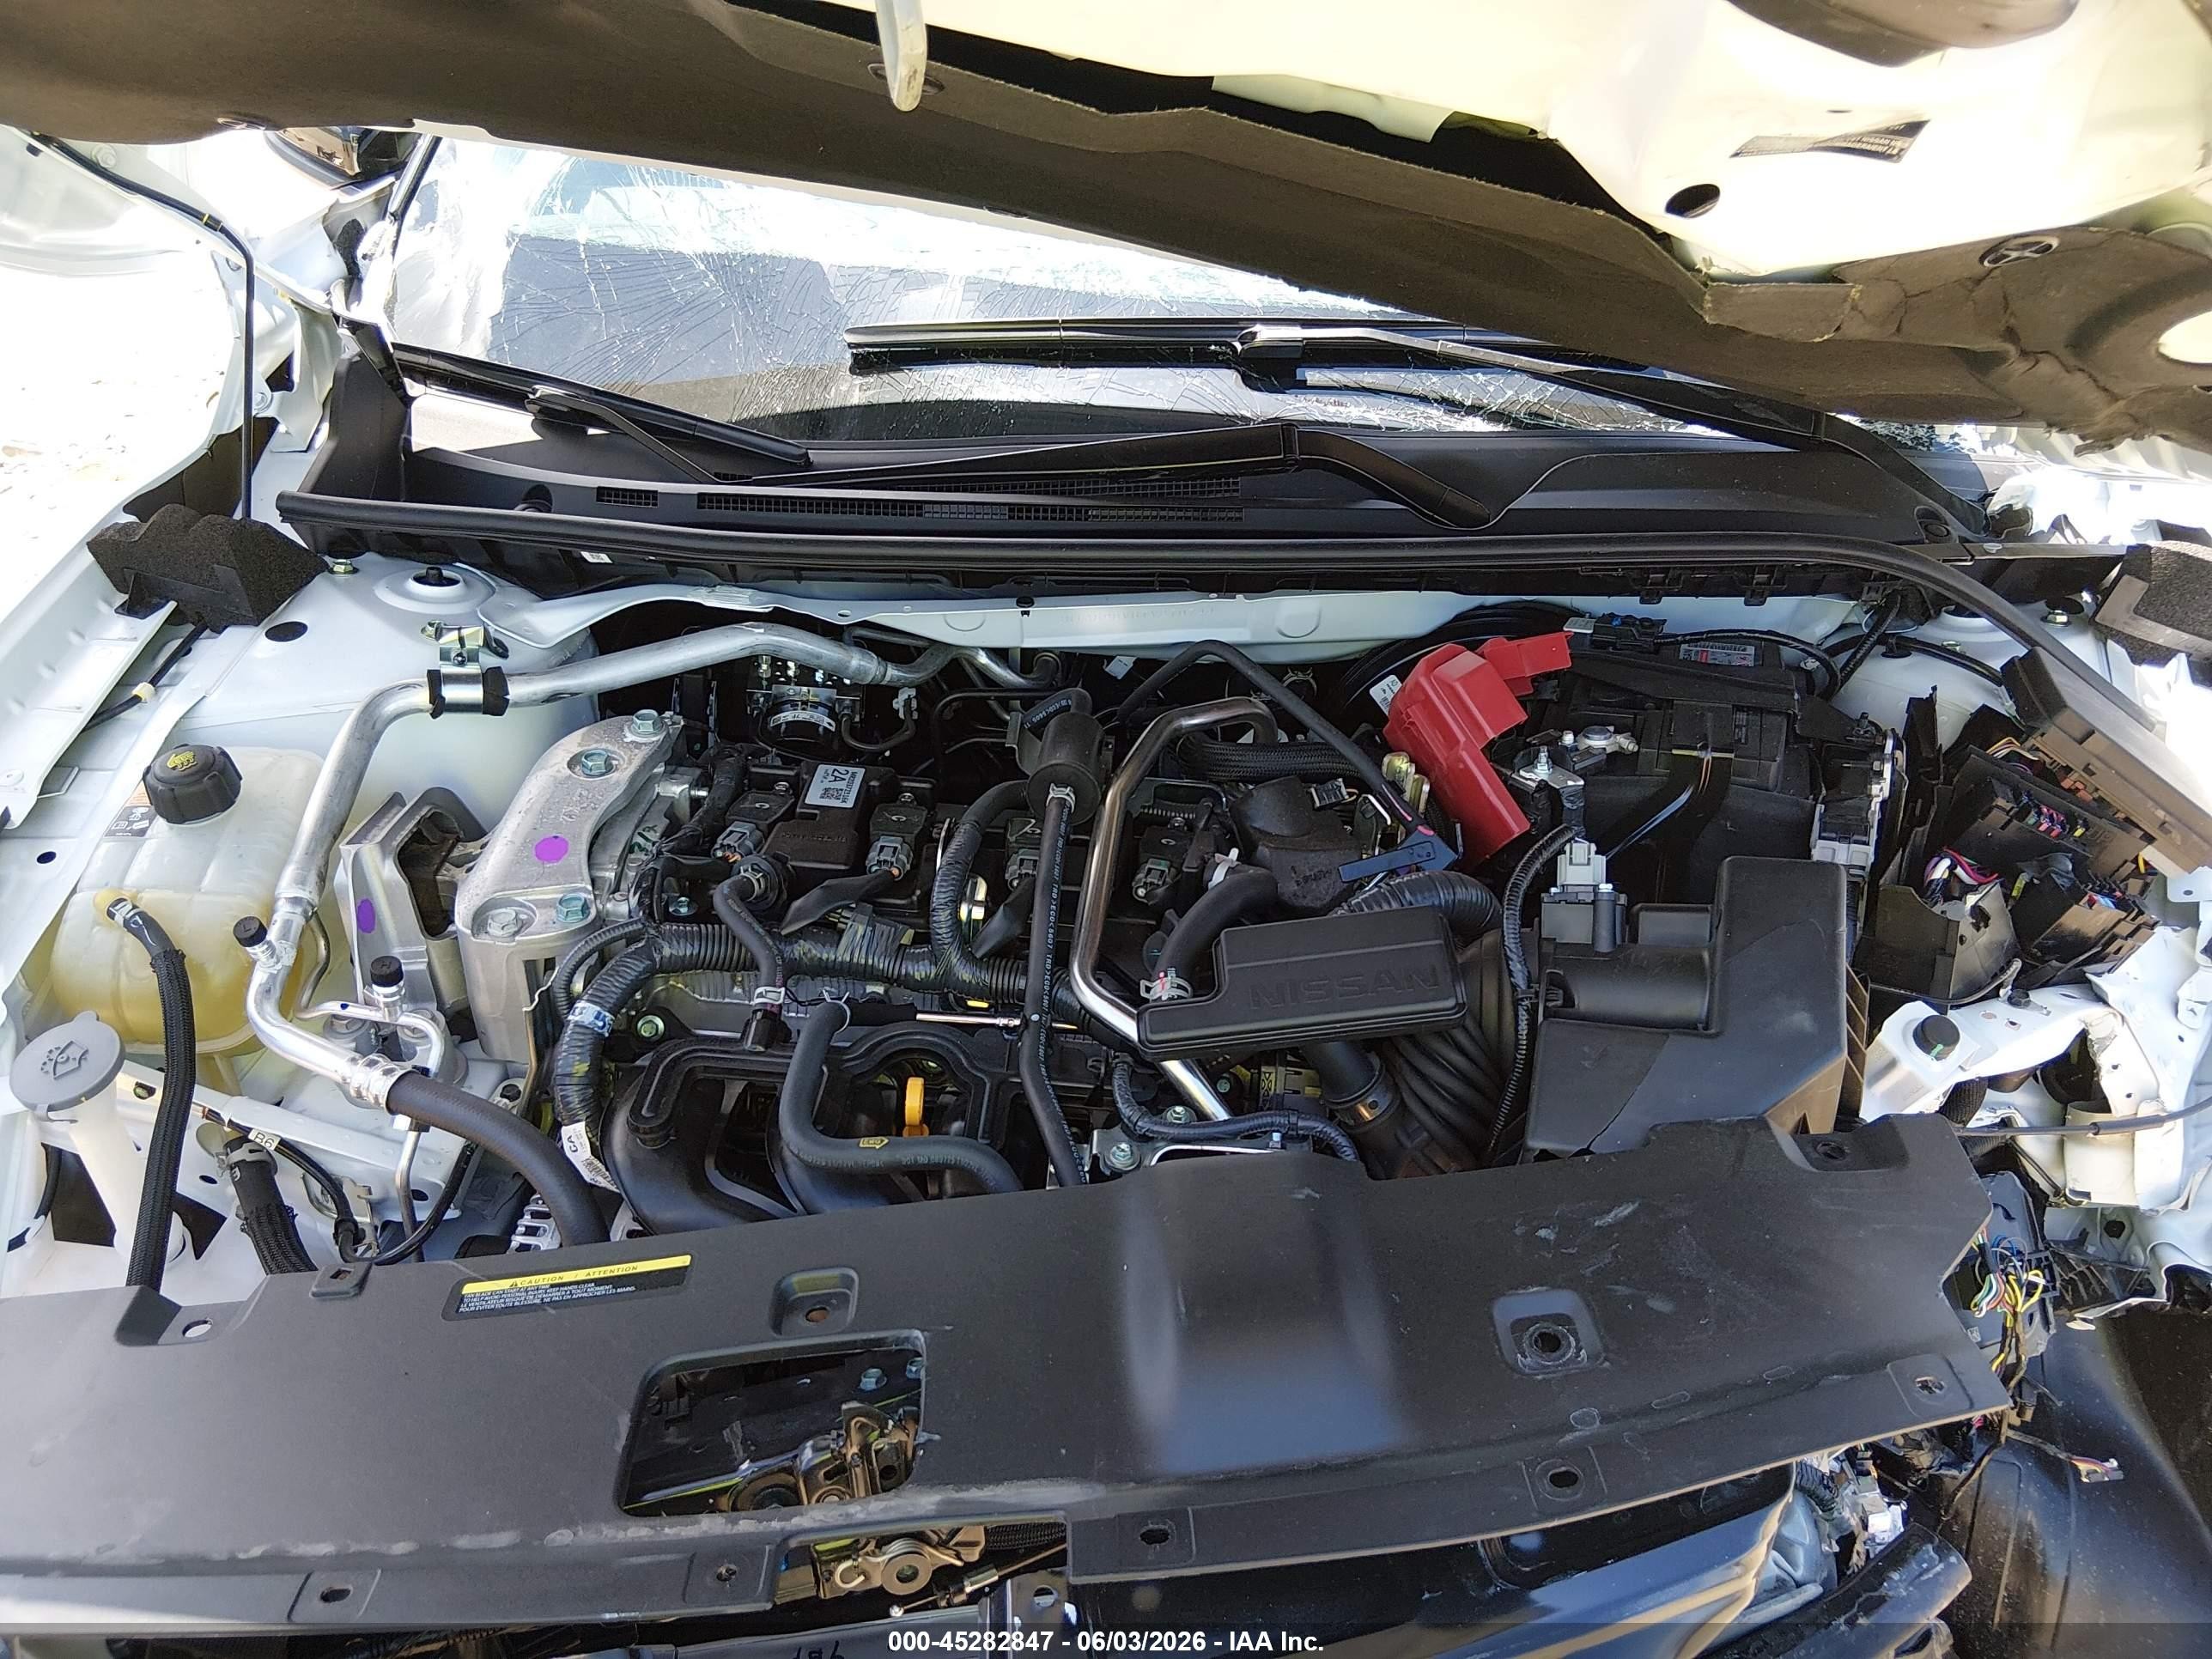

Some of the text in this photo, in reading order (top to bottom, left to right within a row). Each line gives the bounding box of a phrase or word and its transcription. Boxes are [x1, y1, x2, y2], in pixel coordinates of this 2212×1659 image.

[828, 768, 849, 782] 2A
[1249, 963, 1440, 1010] NISSAN
[520, 1275, 564, 1285] CAUTION
[586, 1265, 639, 1278] ATTENTION
[468, 1297, 505, 1306] VENTILATEUR
